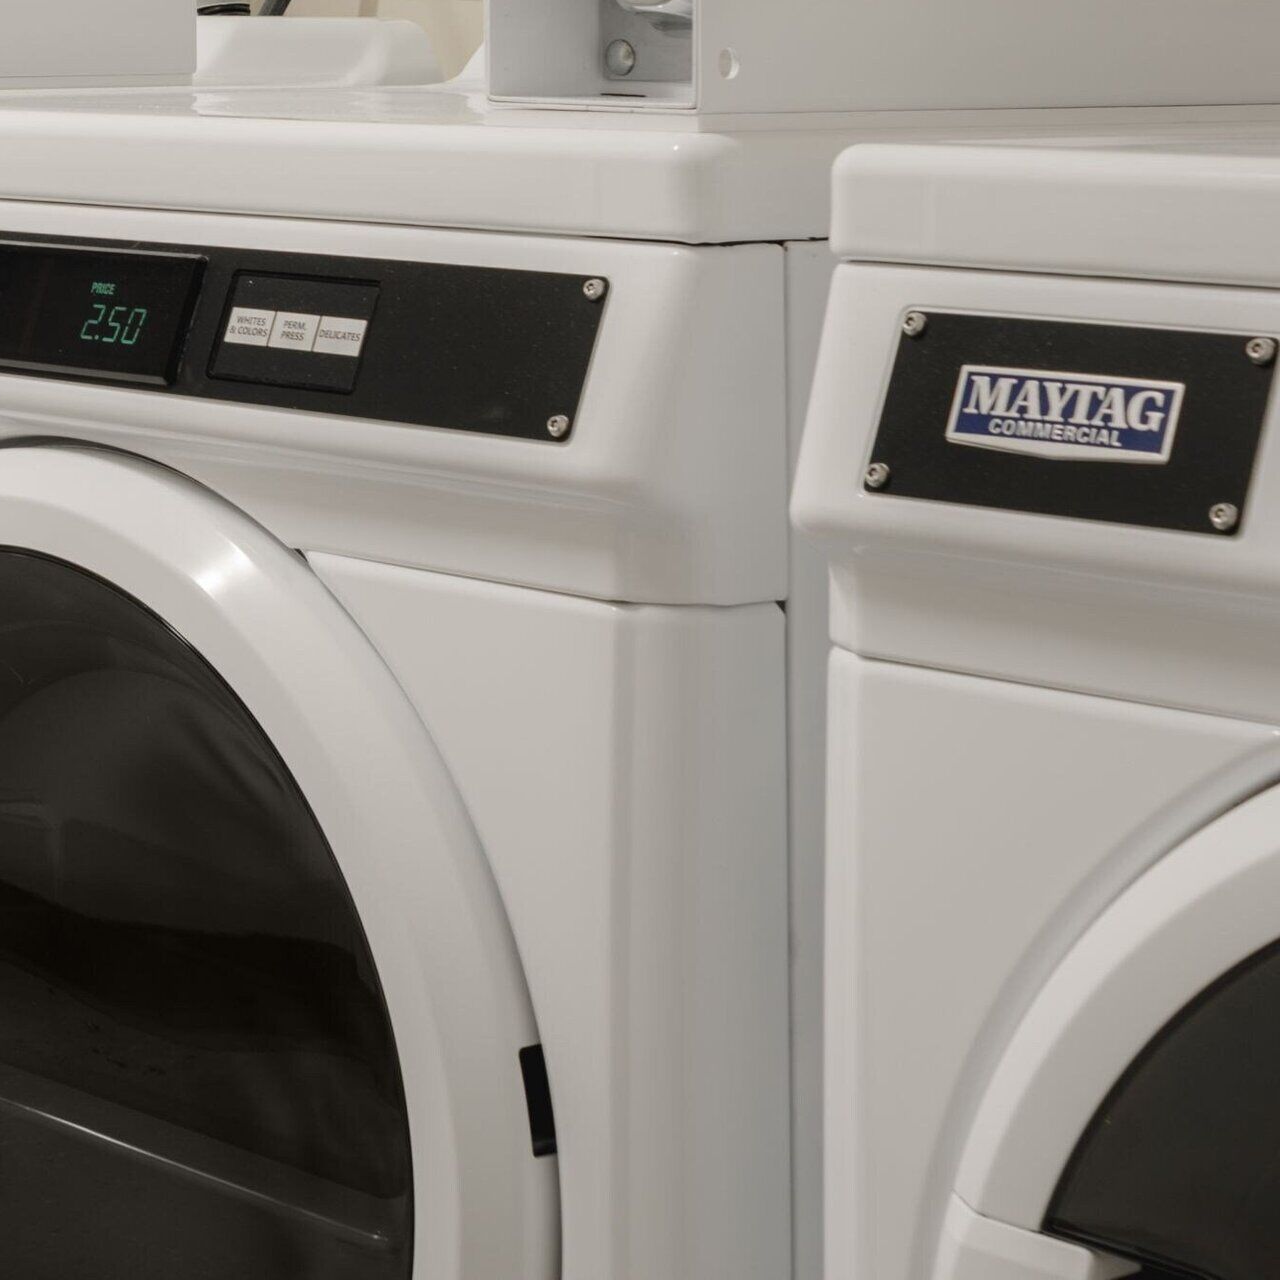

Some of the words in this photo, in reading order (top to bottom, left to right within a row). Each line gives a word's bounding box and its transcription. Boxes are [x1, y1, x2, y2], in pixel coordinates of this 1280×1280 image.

[90, 281, 117, 296] PRICE
[79, 303, 148, 345] 2.50
[236, 315, 267, 327] WHITES
[238, 326, 269, 338] COLORS
[280, 330, 305, 341] PRESS
[319, 329, 361, 342] DELICATES
[962, 375, 1166, 433] MAYTAG
[988, 418, 1123, 447] COMMERCIAL
